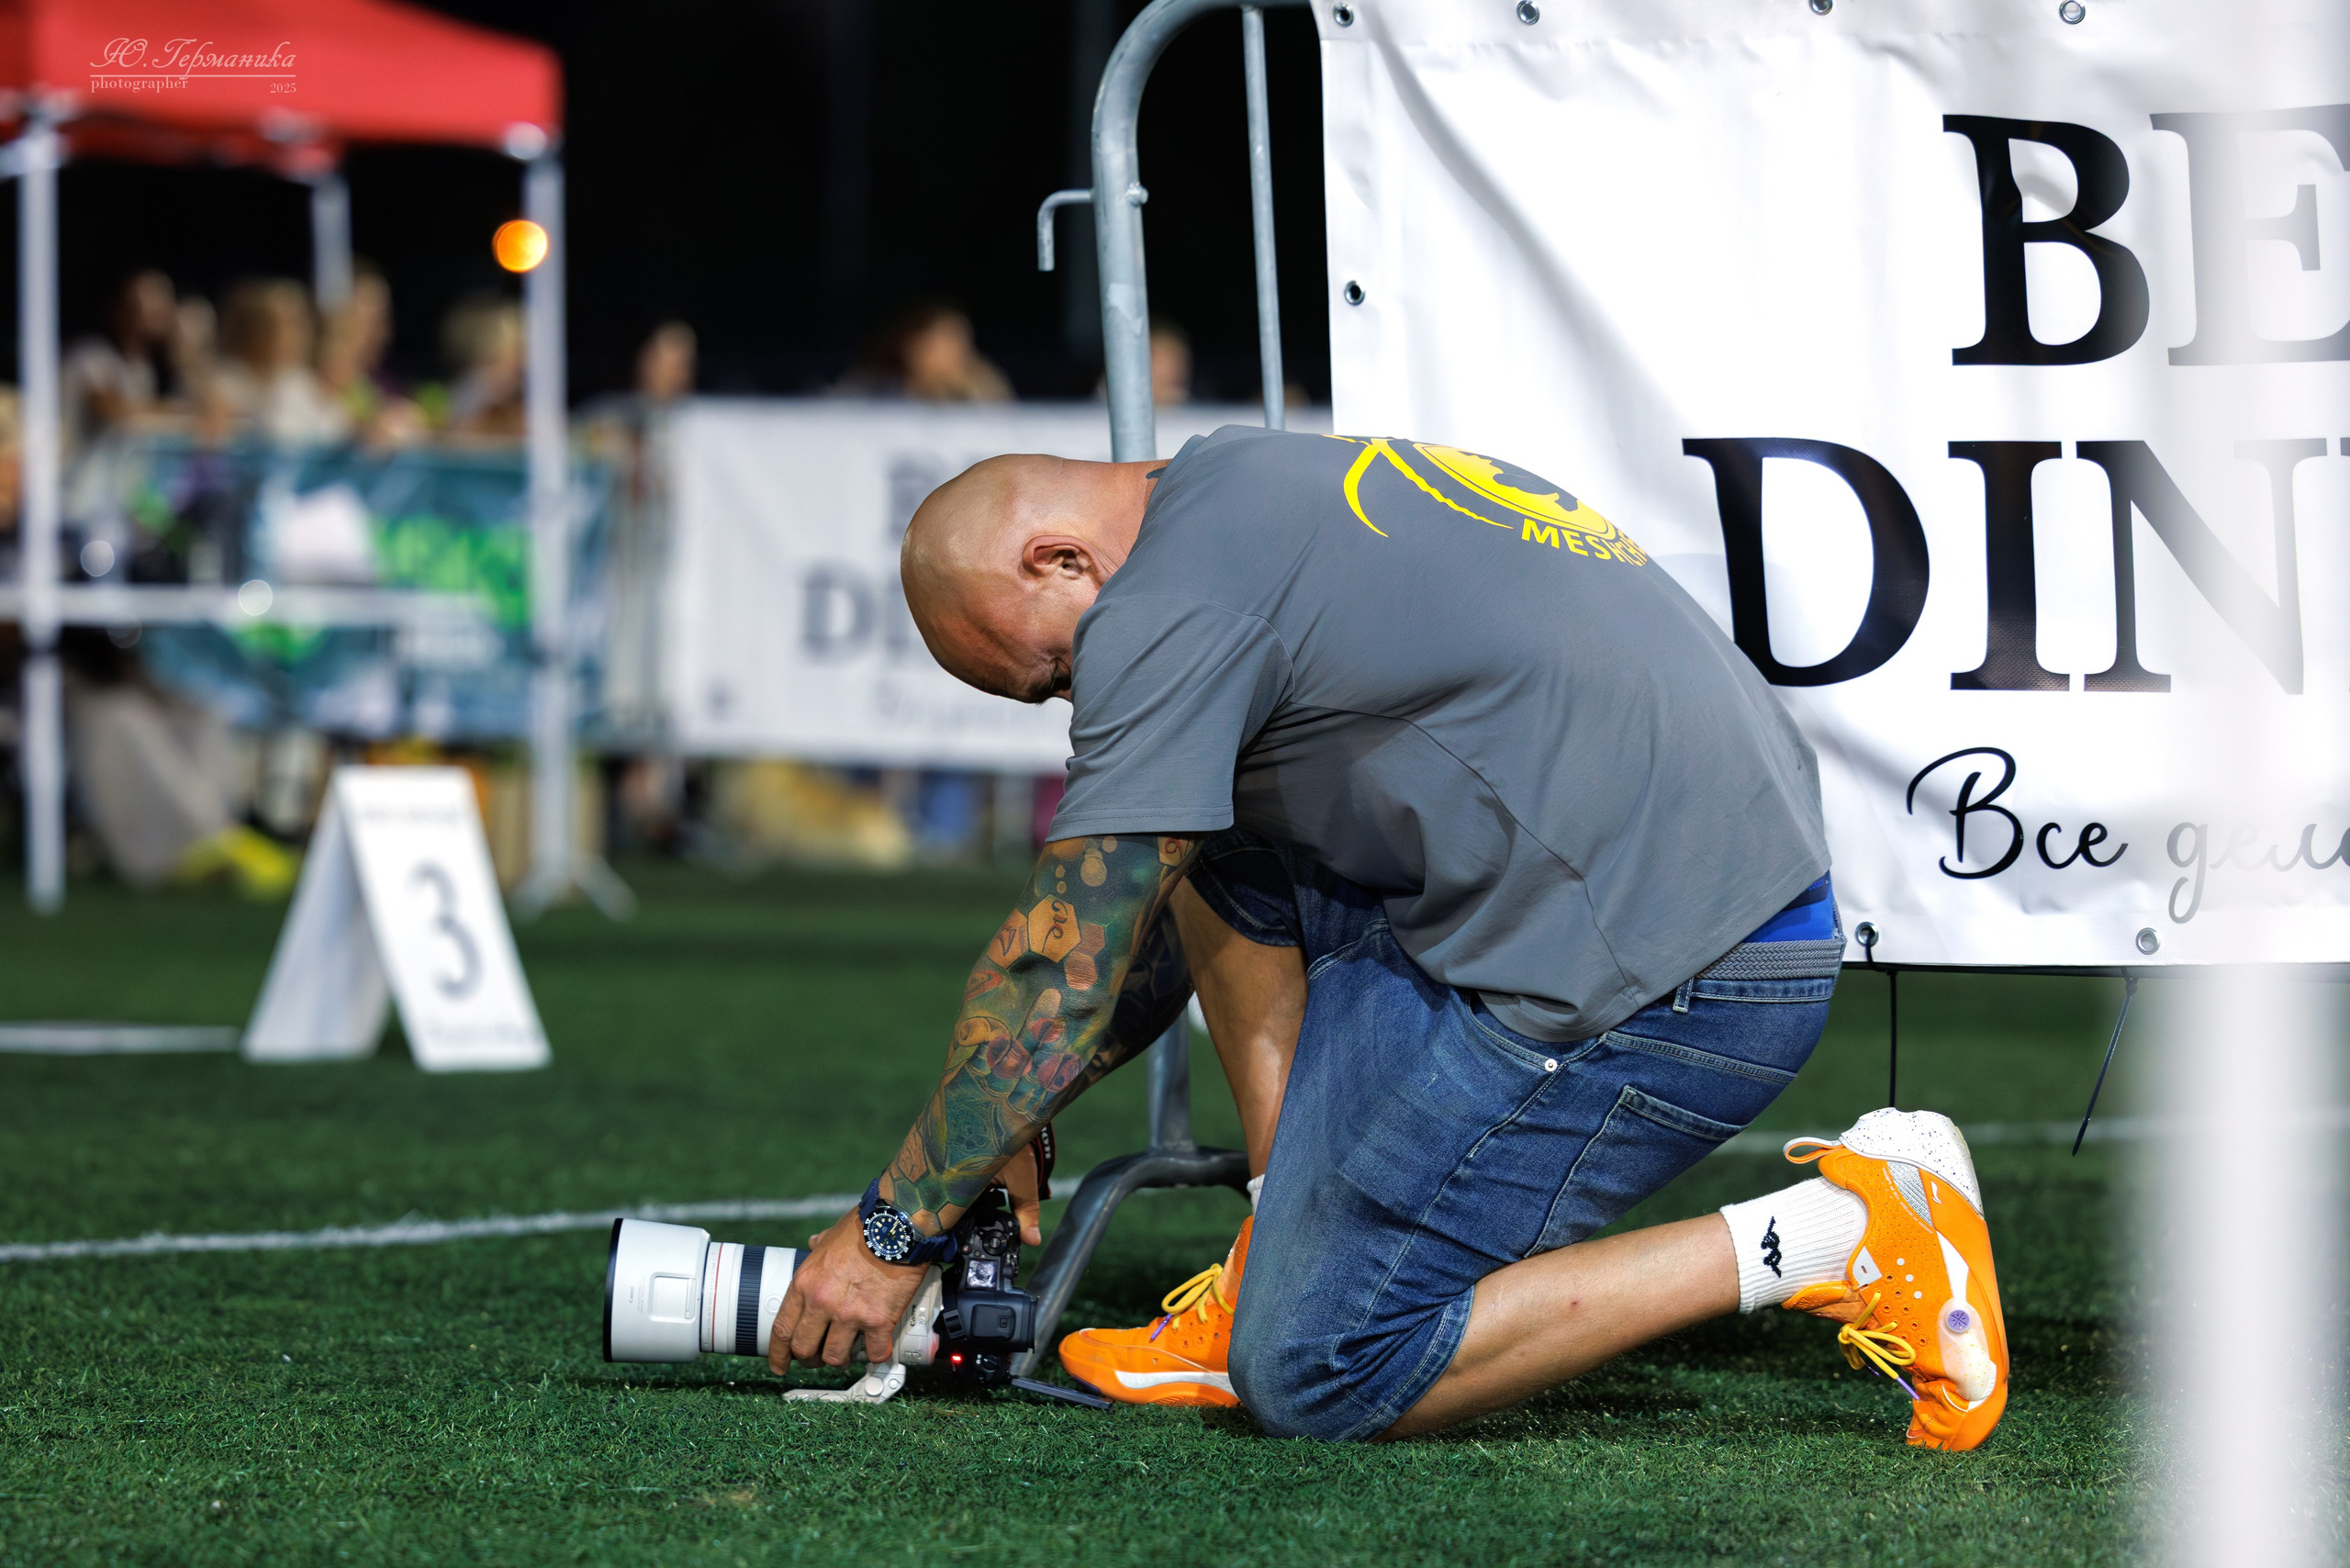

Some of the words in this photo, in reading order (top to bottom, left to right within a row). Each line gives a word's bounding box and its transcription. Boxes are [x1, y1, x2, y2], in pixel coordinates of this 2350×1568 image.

[1682, 436, 2350, 695] DIN
[1906, 746, 2129, 879] Все
[2166, 822, 2350, 924] дел
[408, 859, 484, 1002] 3
[909, 1304, 917, 1327] Canon
